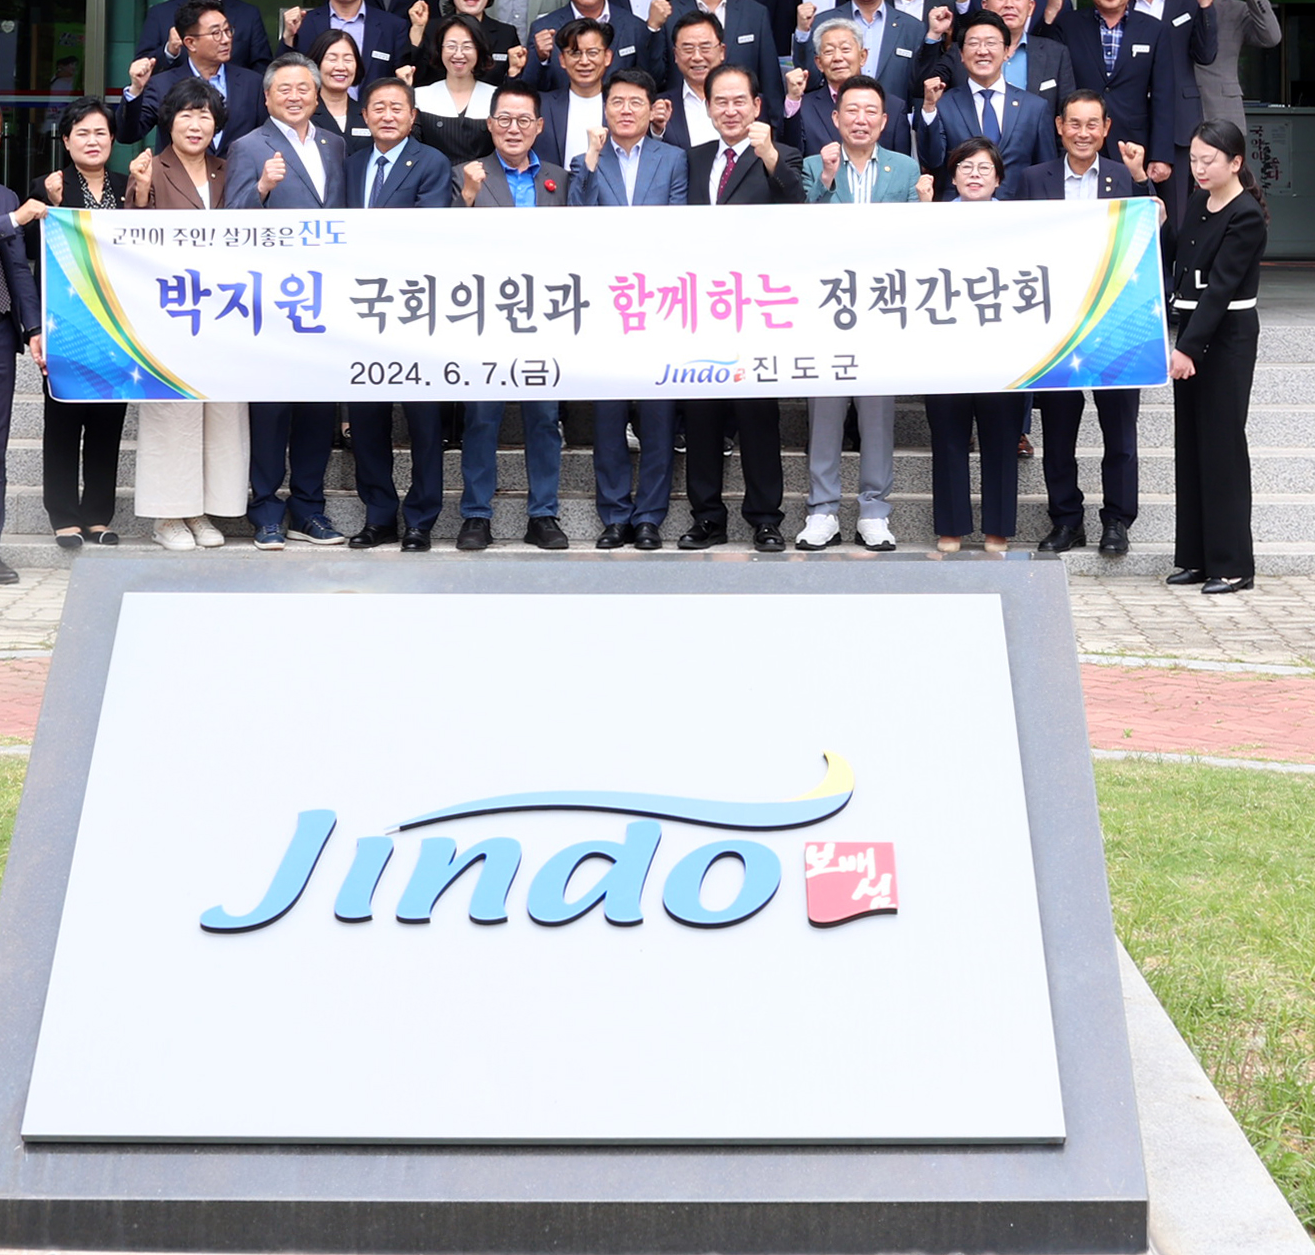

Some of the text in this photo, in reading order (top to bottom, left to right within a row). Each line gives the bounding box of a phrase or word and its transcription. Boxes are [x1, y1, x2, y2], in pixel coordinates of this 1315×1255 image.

[112, 227, 164, 246] 군민이
[173, 227, 216, 247] 주인!
[155, 264, 1052, 337] 박지원 국회의원과 함께하는 정책간담회
[350, 358, 561, 388] 2024. 6. 7.(금)
[655, 364, 730, 386] Jindo
[199, 808, 783, 934] Jindo
